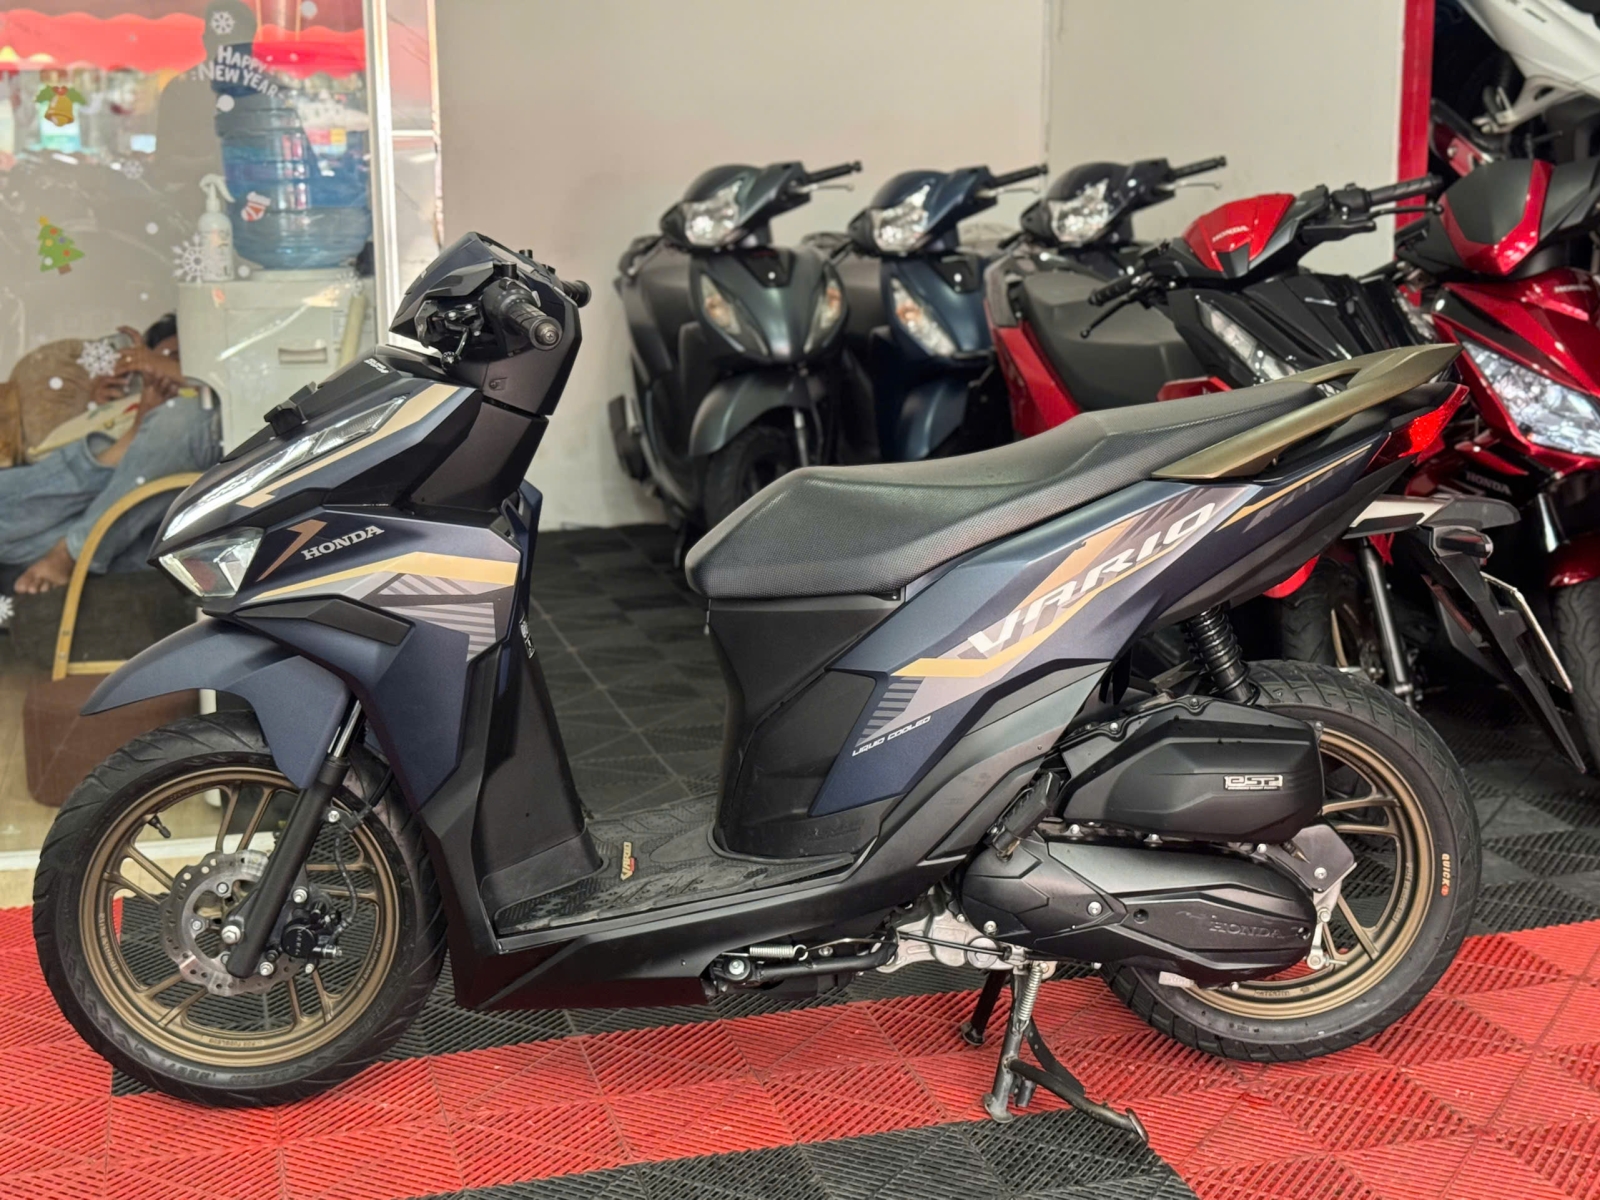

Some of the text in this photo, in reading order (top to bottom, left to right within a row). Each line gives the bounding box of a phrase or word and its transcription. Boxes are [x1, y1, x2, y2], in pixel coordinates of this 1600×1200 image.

[217, 45, 267, 74] HAPPY
[198, 60, 279, 98] NEW YEAR
[1466, 471, 1512, 495] HONDA
[301, 525, 385, 560] HONDA
[968, 502, 1215, 653] VARIO
[851, 715, 931, 757] LIQUID COOLED
[620, 841, 634, 881] VARIO
[1441, 853, 1451, 886] QUICK
[1209, 921, 1284, 938] HONDA
